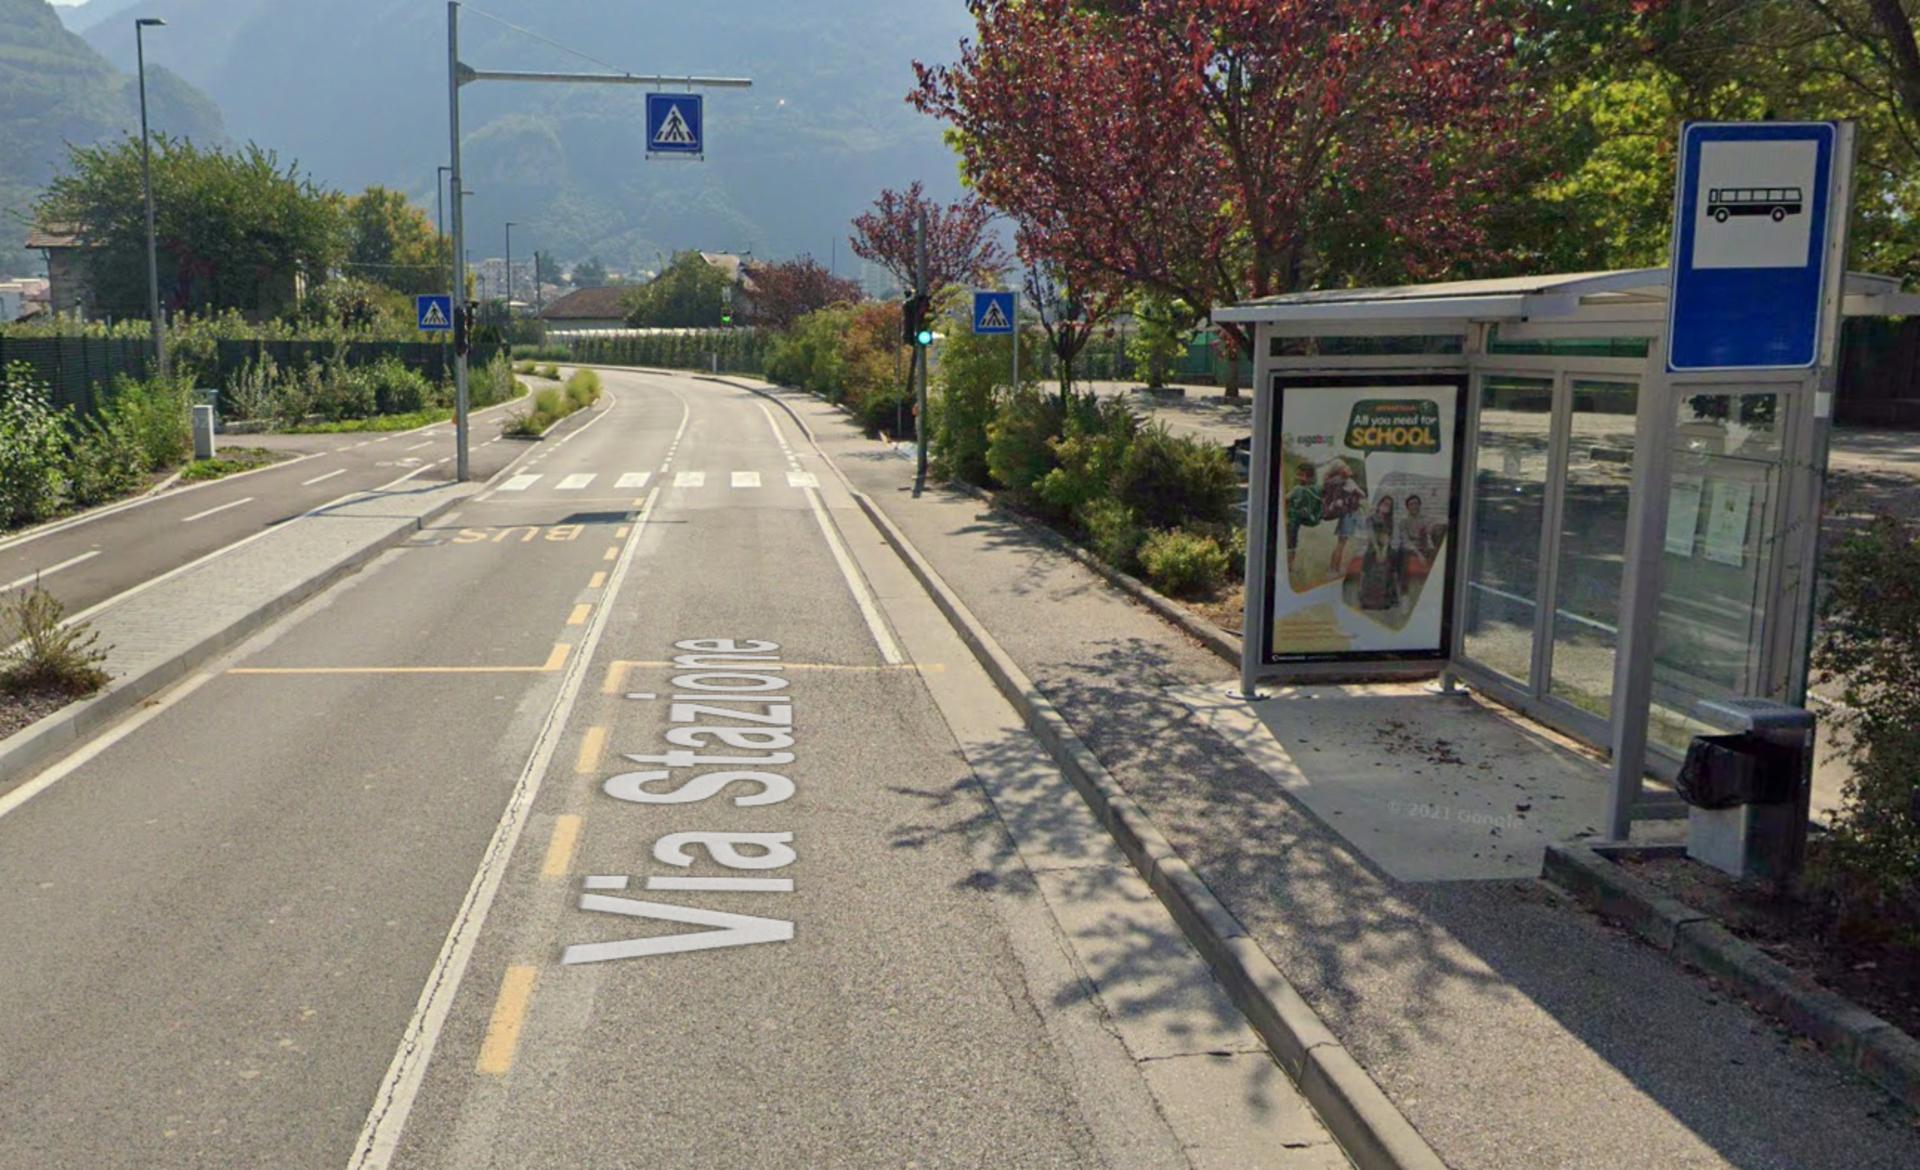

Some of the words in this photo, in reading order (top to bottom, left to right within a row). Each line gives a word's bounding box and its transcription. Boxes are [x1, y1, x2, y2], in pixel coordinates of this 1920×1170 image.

[1354, 414, 1369, 425] All
[1371, 417, 1391, 427] you
[1393, 415, 1419, 425] need
[1421, 415, 1437, 425] for
[1352, 427, 1436, 446] SCHOOL
[453, 524, 585, 544] BUS
